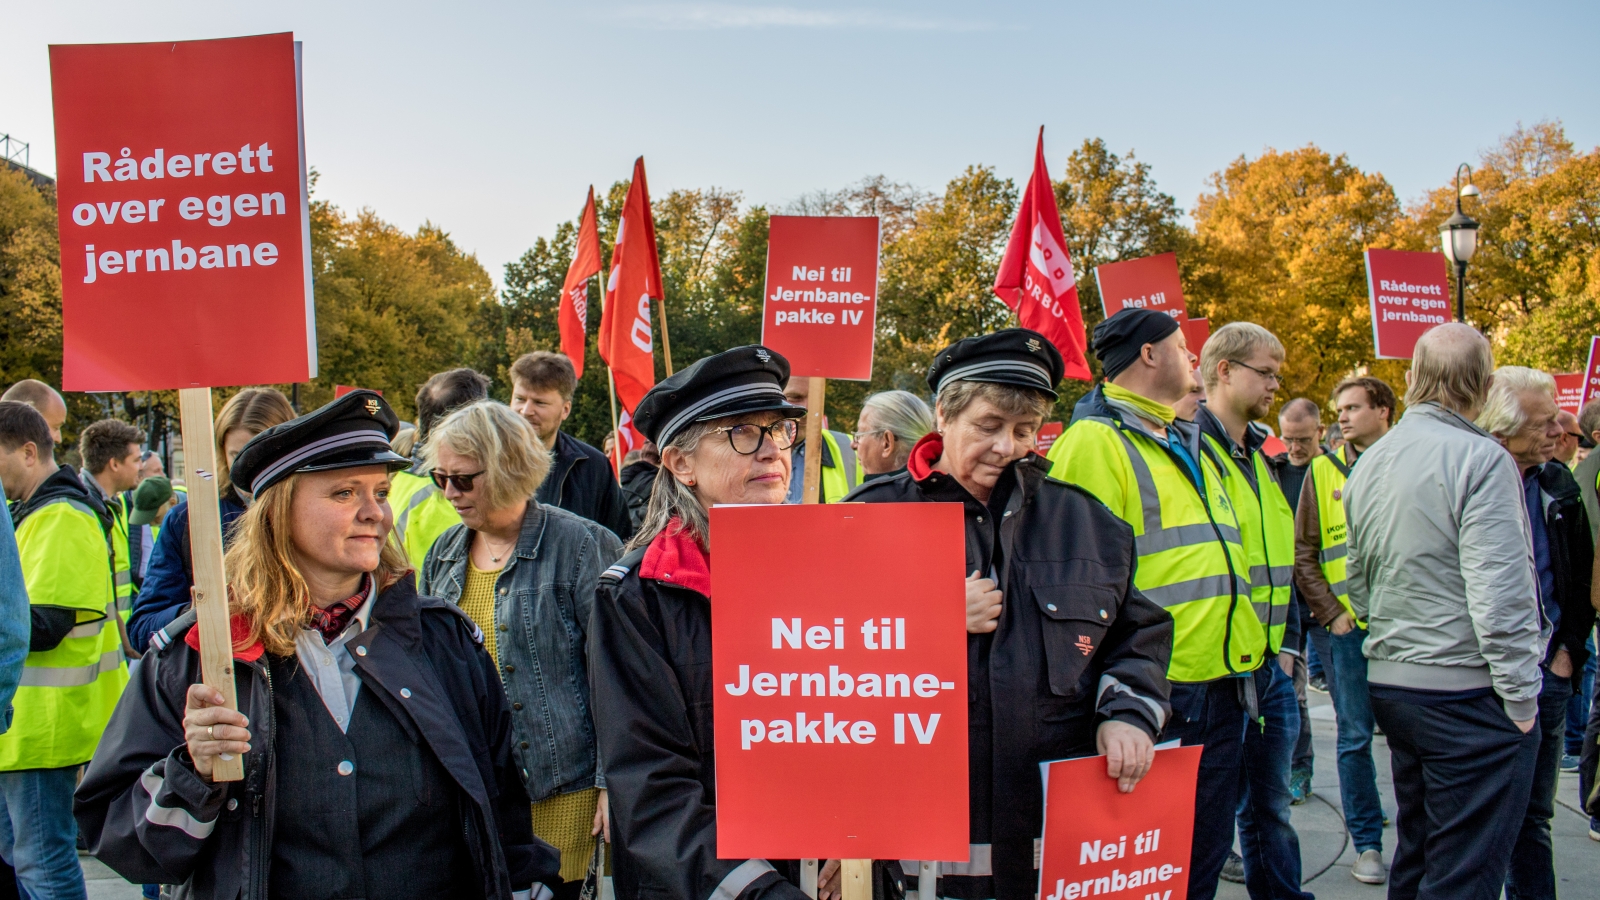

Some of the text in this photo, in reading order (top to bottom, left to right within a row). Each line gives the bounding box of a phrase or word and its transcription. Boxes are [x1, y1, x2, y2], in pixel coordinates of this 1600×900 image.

[82, 142, 274, 183] Råderett
[72, 191, 286, 227] over egen
[83, 239, 279, 284] jernbane
[792, 265, 852, 282] Nei til
[770, 286, 871, 304] Jernbane-
[1122, 291, 1167, 309] Nei til
[1380, 279, 1442, 296] Råderett
[1378, 295, 1447, 311] over egen
[775, 308, 864, 326] pakke IV
[1382, 308, 1445, 324] jernbane
[771, 617, 906, 650] Nei til
[1078, 634, 1091, 645] NSB
[724, 664, 955, 698] Jernbane-
[740, 711, 942, 751] pakke IV
[1078, 828, 1161, 866] Nei til
[1046, 863, 1183, 900] Jernbane-
